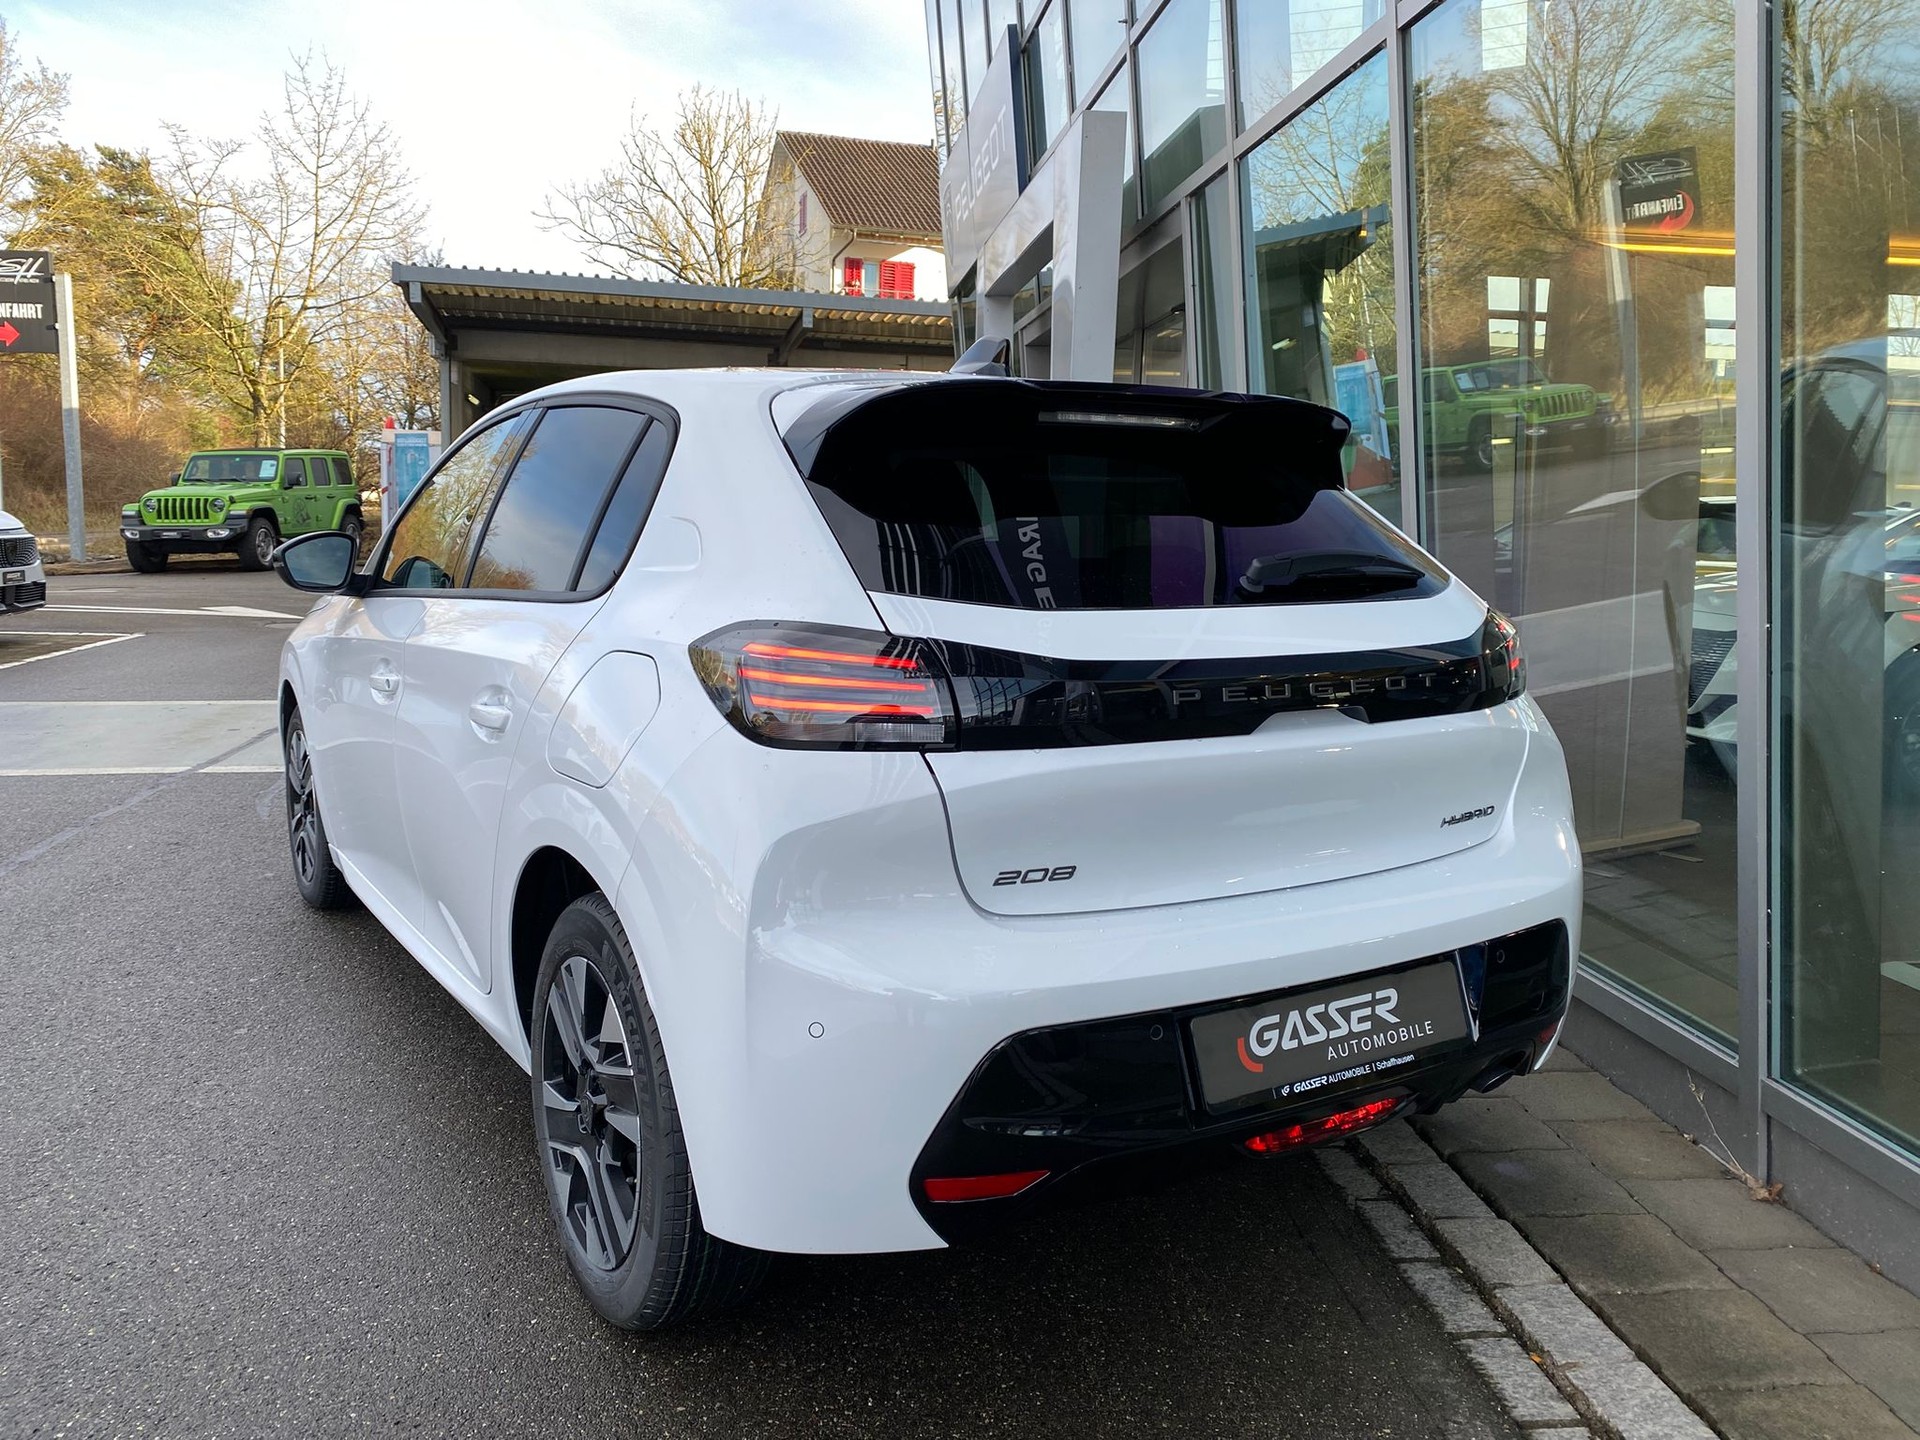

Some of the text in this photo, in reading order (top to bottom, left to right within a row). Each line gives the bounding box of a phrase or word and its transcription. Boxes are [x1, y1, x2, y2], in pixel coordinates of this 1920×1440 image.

[955, 105, 1007, 232] PEUGEOT
[1172, 672, 1437, 705] PEUGEOT
[1440, 805, 1495, 829] HYBRID
[992, 865, 1077, 887] 208
[1249, 987, 1401, 1057] GASSER
[1327, 1020, 1435, 1061] AUTOMOBILE
[1293, 1075, 1328, 1093] GASSER
[1328, 1064, 1371, 1083] AUTOMOBILE
[1376, 1054, 1415, 1070] Schaffhausen
